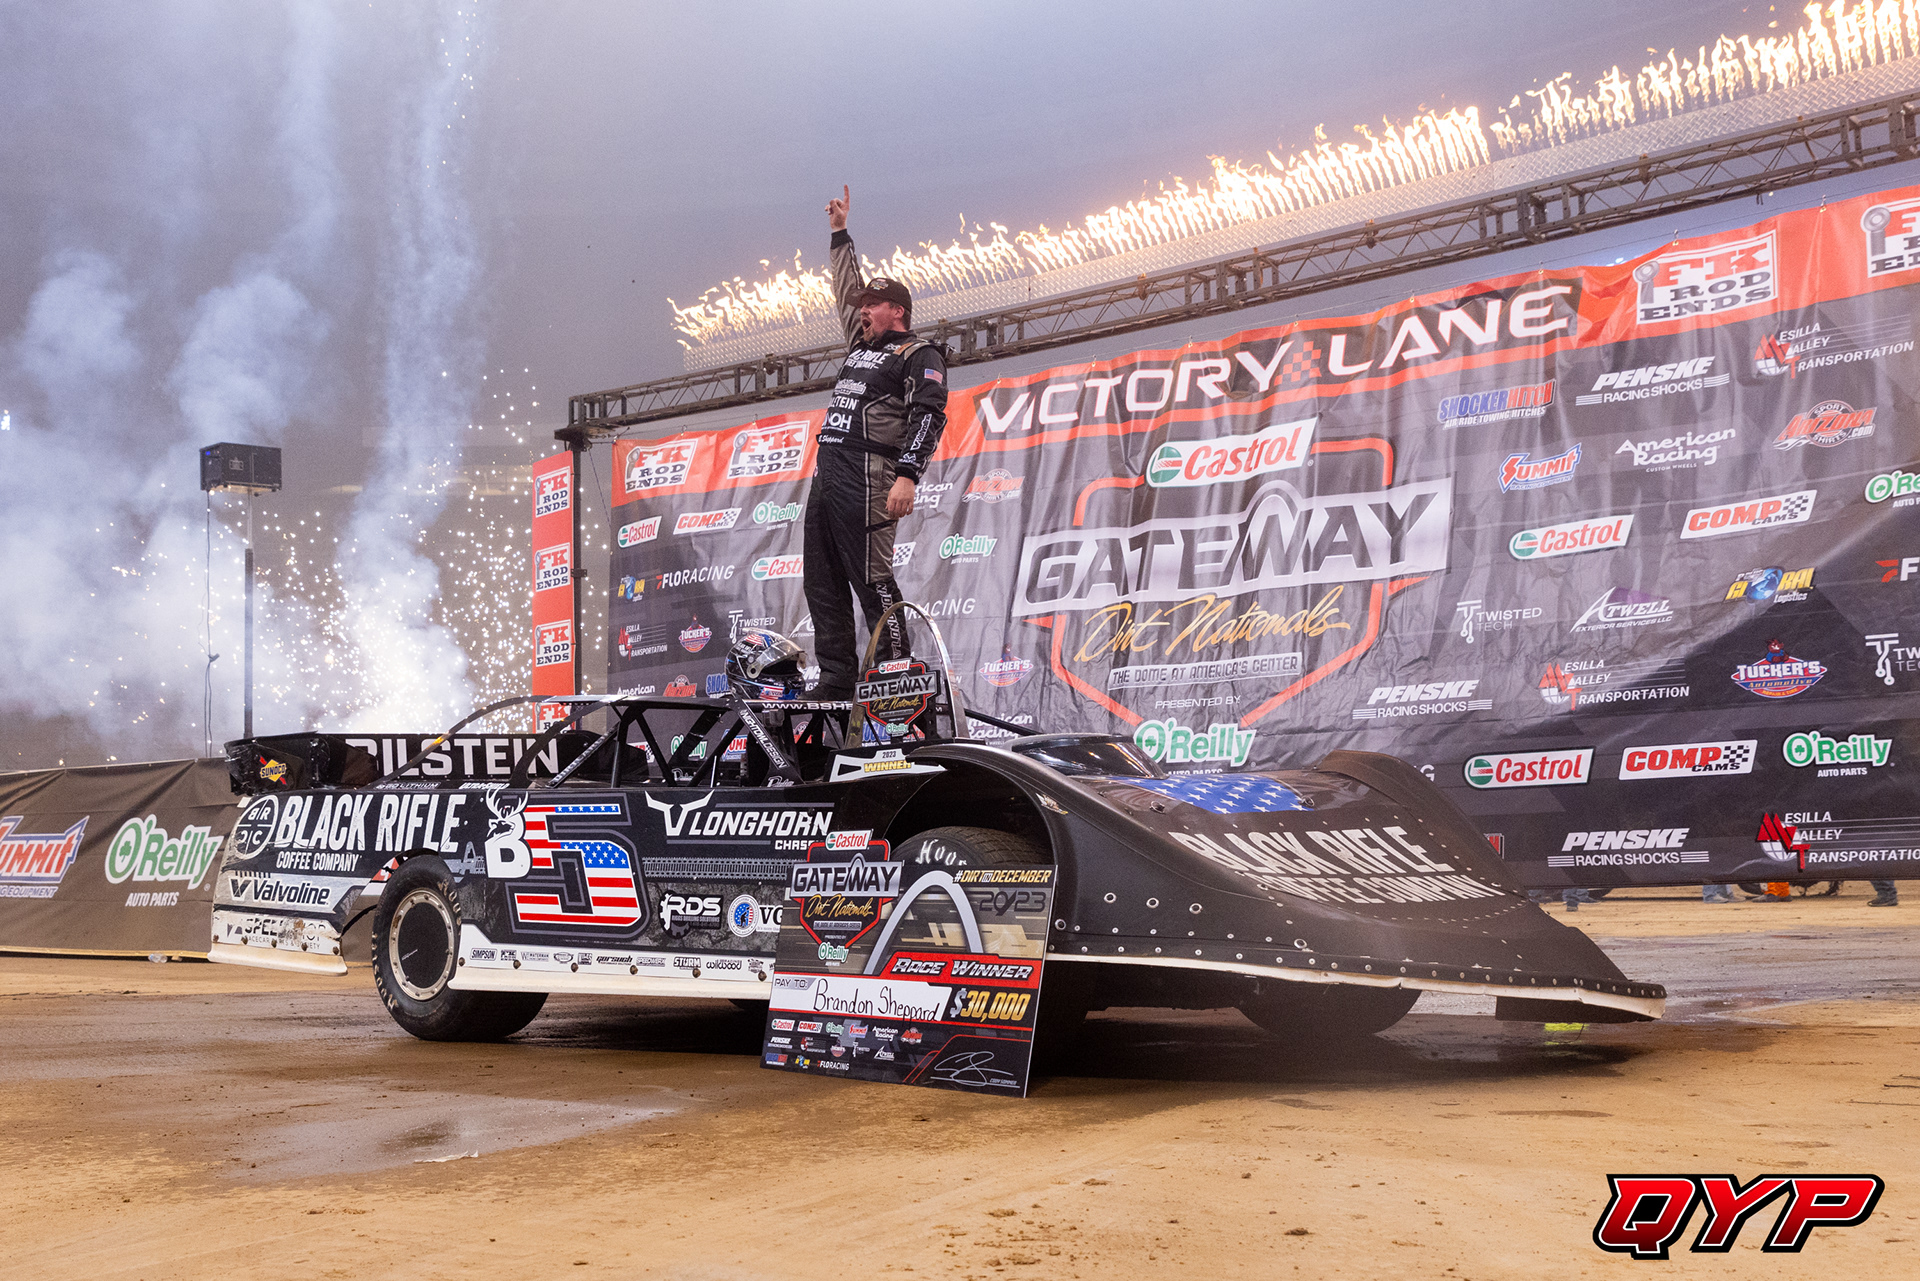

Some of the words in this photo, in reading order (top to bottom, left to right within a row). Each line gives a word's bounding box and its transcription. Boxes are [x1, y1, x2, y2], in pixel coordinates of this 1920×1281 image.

[1656, 238, 1770, 288] FK
[1670, 270, 1771, 302] ROD
[1639, 286, 1772, 322] ENDS
[979, 340, 1297, 434] VICTORY
[1326, 286, 1574, 376] LANE
[1592, 356, 1716, 391] PENSKE
[1603, 385, 1651, 404] RACING
[1651, 378, 1703, 399] SHOCKS
[1459, 414, 1478, 426] RIDE
[1479, 411, 1510, 424] TOWING
[1511, 406, 1546, 419] HITCHES
[1814, 403, 1845, 415] SPORT
[742, 427, 803, 453] FK
[1615, 428, 1736, 455] American
[634, 444, 691, 468] FK
[747, 449, 801, 464] ROD
[1183, 425, 1302, 481] Castrol
[1633, 444, 1719, 467] Racing
[638, 463, 686, 478] ROD
[729, 459, 798, 477] ENDS
[539, 472, 568, 496] FK
[626, 474, 683, 491] ENDS
[537, 499, 568, 515] ENDS
[543, 490, 568, 504] ROD
[677, 512, 725, 529] COMP
[754, 501, 802, 523] O'Reilly
[1688, 499, 1783, 531] COMP
[1751, 511, 1799, 526] CAMS
[628, 520, 656, 543] Castrol
[1539, 519, 1623, 554] Castrol
[940, 534, 996, 558] O'Reilly
[1026, 490, 1440, 605] GATEWAY
[539, 549, 568, 571] FK
[543, 565, 568, 578] ROD
[662, 564, 735, 589] FLORACING
[536, 575, 568, 591] ENDS
[738, 616, 776, 628] TWISTED
[1074, 602, 1170, 663] Dirt
[1165, 585, 1351, 656] Nationals
[1476, 607, 1542, 621] TWISTED
[539, 625, 569, 645] FK
[681, 627, 710, 639] TUCKER'S
[1477, 620, 1513, 632] TECH
[1575, 623, 1615, 633] EXTERIOR
[1616, 619, 1656, 629] SERVICES
[544, 642, 570, 654] ROD
[537, 652, 570, 666] ENDS
[886, 661, 908, 672] Castrol
[983, 659, 1031, 673] TUCKER'S
[1112, 668, 1131, 684] THE
[1134, 666, 1167, 683] DOME
[1171, 665, 1187, 681] AT
[1189, 661, 1248, 680] AMERICA'S
[1252, 656, 1298, 674] CENTER
[1737, 660, 1820, 681] TUCKER'S
[858, 676, 933, 700] GATEWAY
[1367, 680, 1479, 705] PENSKE
[1748, 678, 1813, 688] Automotive
[539, 703, 569, 721] FK
[1155, 698, 1222, 710] PRESENTED
[1225, 695, 1240, 705] BY
[1377, 703, 1419, 718] RACING
[1420, 701, 1467, 716] SHOCKS
[1136, 718, 1254, 765] O'Reilly
[1786, 732, 1890, 766] O'Reilly
[882, 750, 897, 758] 2023
[1625, 745, 1721, 773] COMP
[261, 764, 287, 778] SUNOCO
[1496, 753, 1583, 784] Castrol
[1691, 761, 1740, 773] CAMS
[1817, 768, 1842, 777] AUTO
[1844, 767, 1867, 777] PARTS
[274, 794, 373, 852] BLACK
[376, 794, 467, 853] RIFLE
[688, 811, 833, 837] LONGHORN
[835, 833, 867, 848] Castrol
[1168, 830, 1352, 875] BLACK
[1305, 825, 1456, 875] RIFLE
[1561, 828, 1690, 852] PENSKE
[108, 818, 219, 885] O'Reilly
[276, 851, 311, 869] COFFEE
[312, 853, 359, 872] COMPANY
[1576, 853, 1624, 866] RACING
[1624, 851, 1680, 864] SHOCKS
[793, 866, 899, 892] GATEWAY
[8, 886, 57, 898] EQUIPMENT
[125, 893, 151, 907] AUTO
[150, 892, 180, 906] PARTS
[253, 877, 330, 905] Valvoline
[667, 896, 721, 916] RDS
[805, 894, 830, 918] Dirt
[979, 889, 1047, 917] 2023
[472, 949, 495, 959] SIMPSON
[819, 942, 849, 962] O'Reilly
[892, 957, 945, 974] RACE
[951, 960, 1033, 979] WINNER
[775, 978, 791, 987] PAY
[794, 979, 809, 988] TO:
[814, 978, 874, 1014] Brandon
[877, 985, 941, 1024] Sheppard
[950, 988, 1032, 1023] $30,000
[776, 1020, 793, 1029] Castrol
[799, 1021, 816, 1030] COMP
